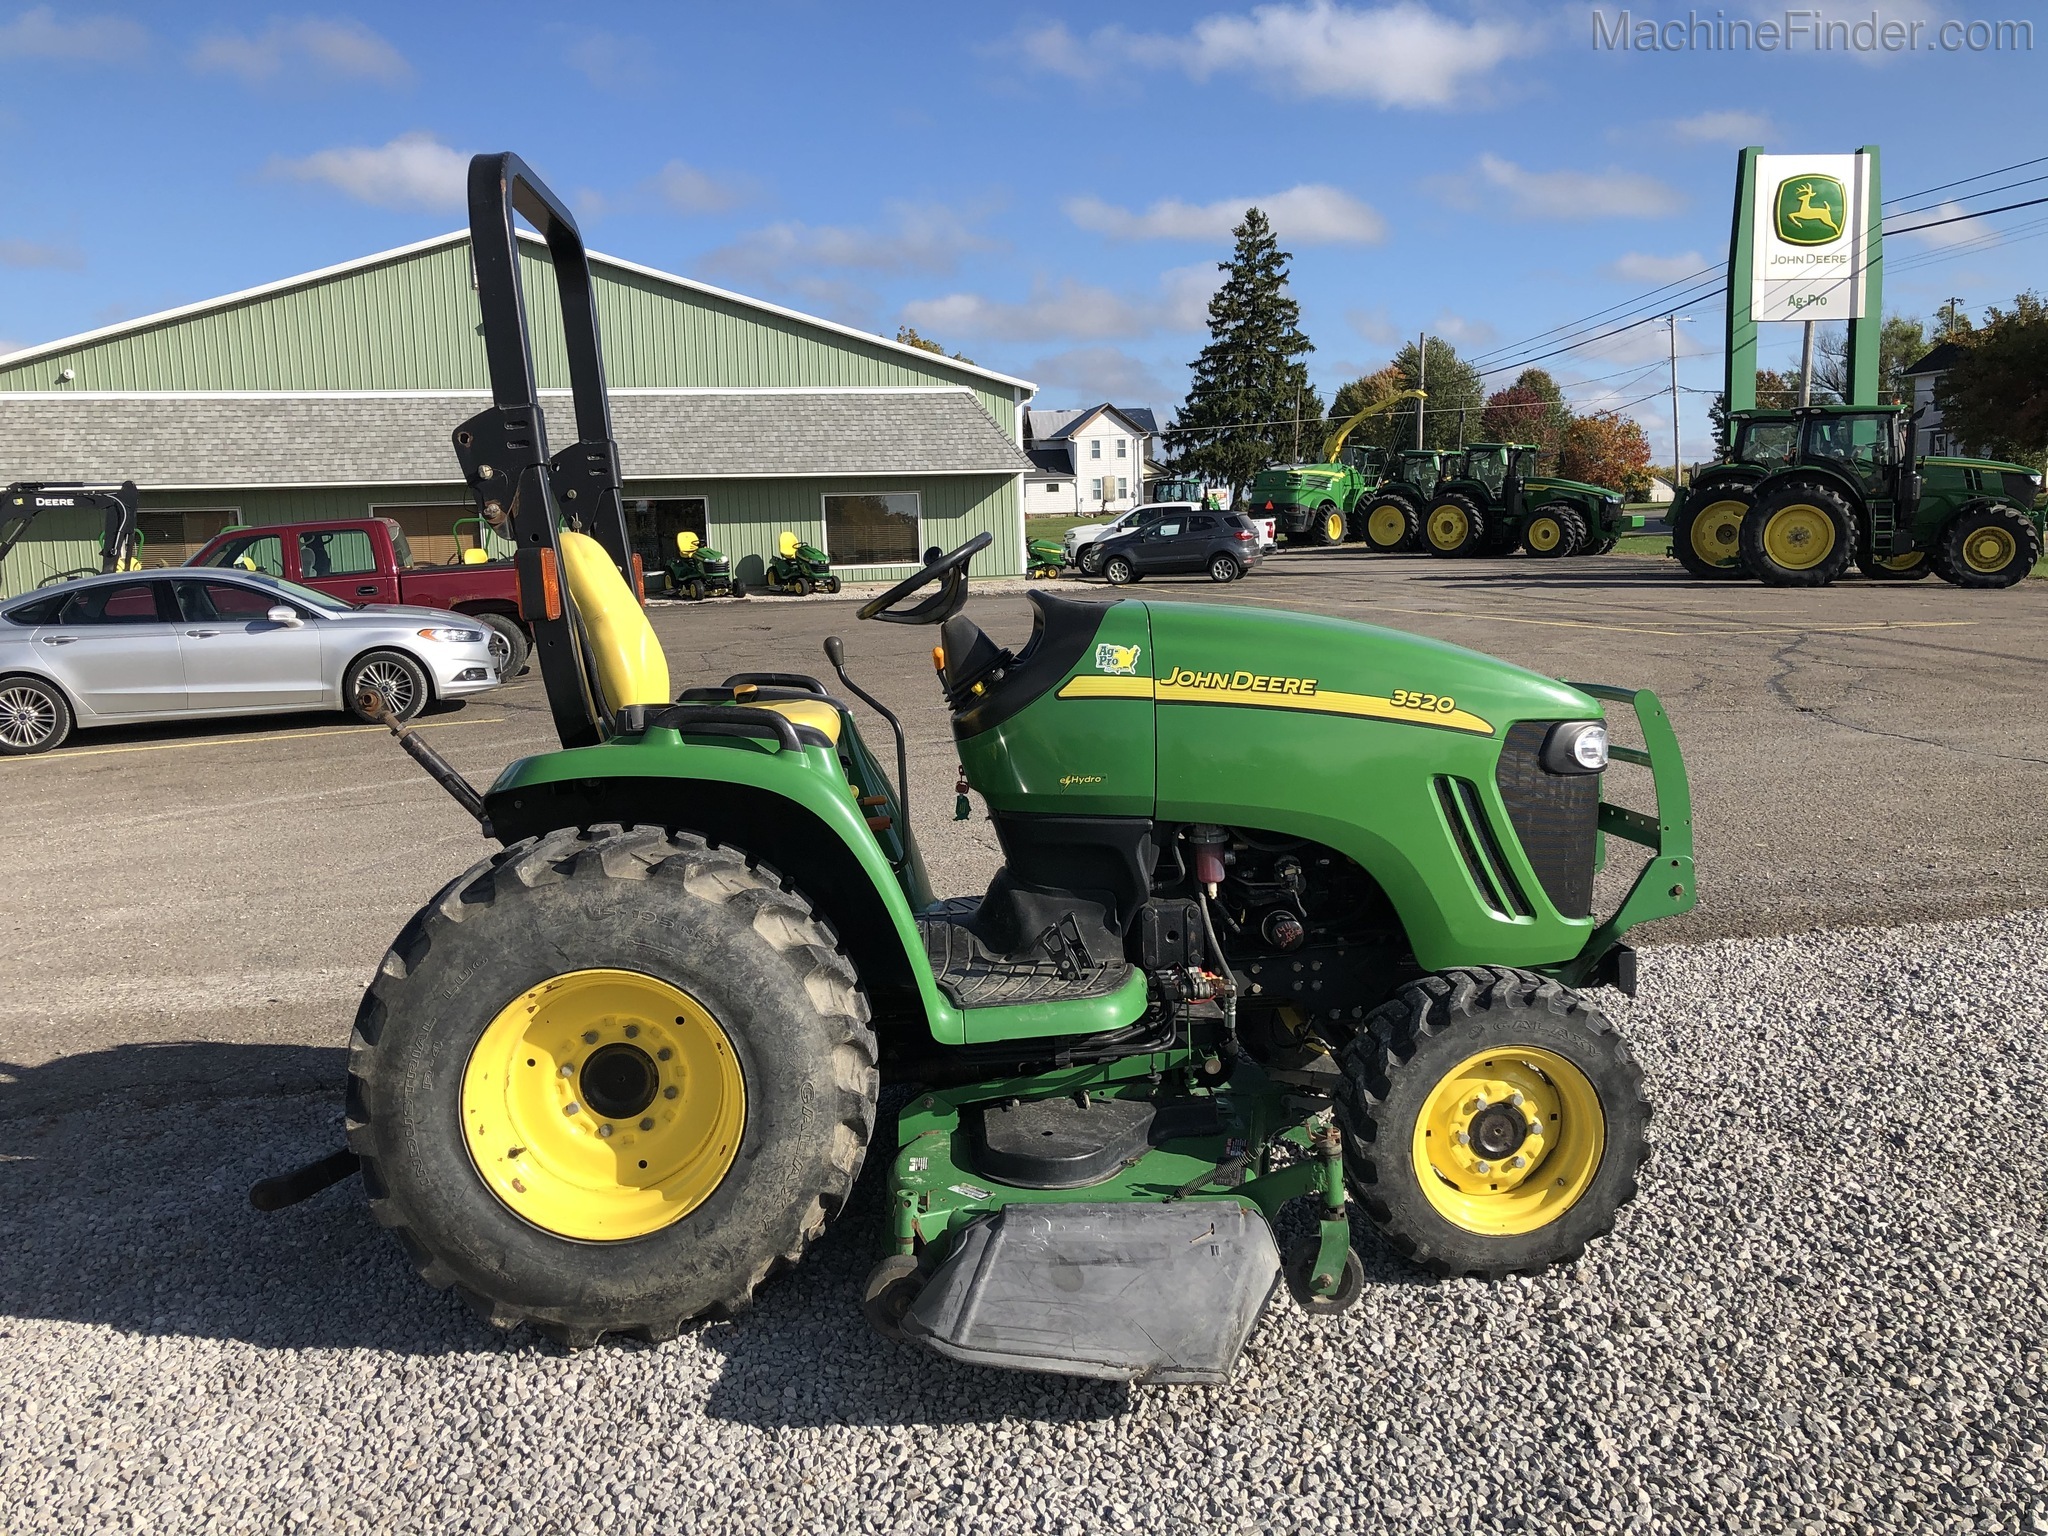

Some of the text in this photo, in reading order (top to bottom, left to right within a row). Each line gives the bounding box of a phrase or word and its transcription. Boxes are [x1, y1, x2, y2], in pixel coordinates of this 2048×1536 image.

[1770, 253, 1847, 264] JOHN DEERE
[1787, 294, 1828, 309] Ag-Pro
[35, 497, 75, 506] DEERE
[1099, 656, 1119, 666] Pro
[1160, 666, 1318, 695] JOHN DEERE
[1390, 689, 1456, 713] 3520
